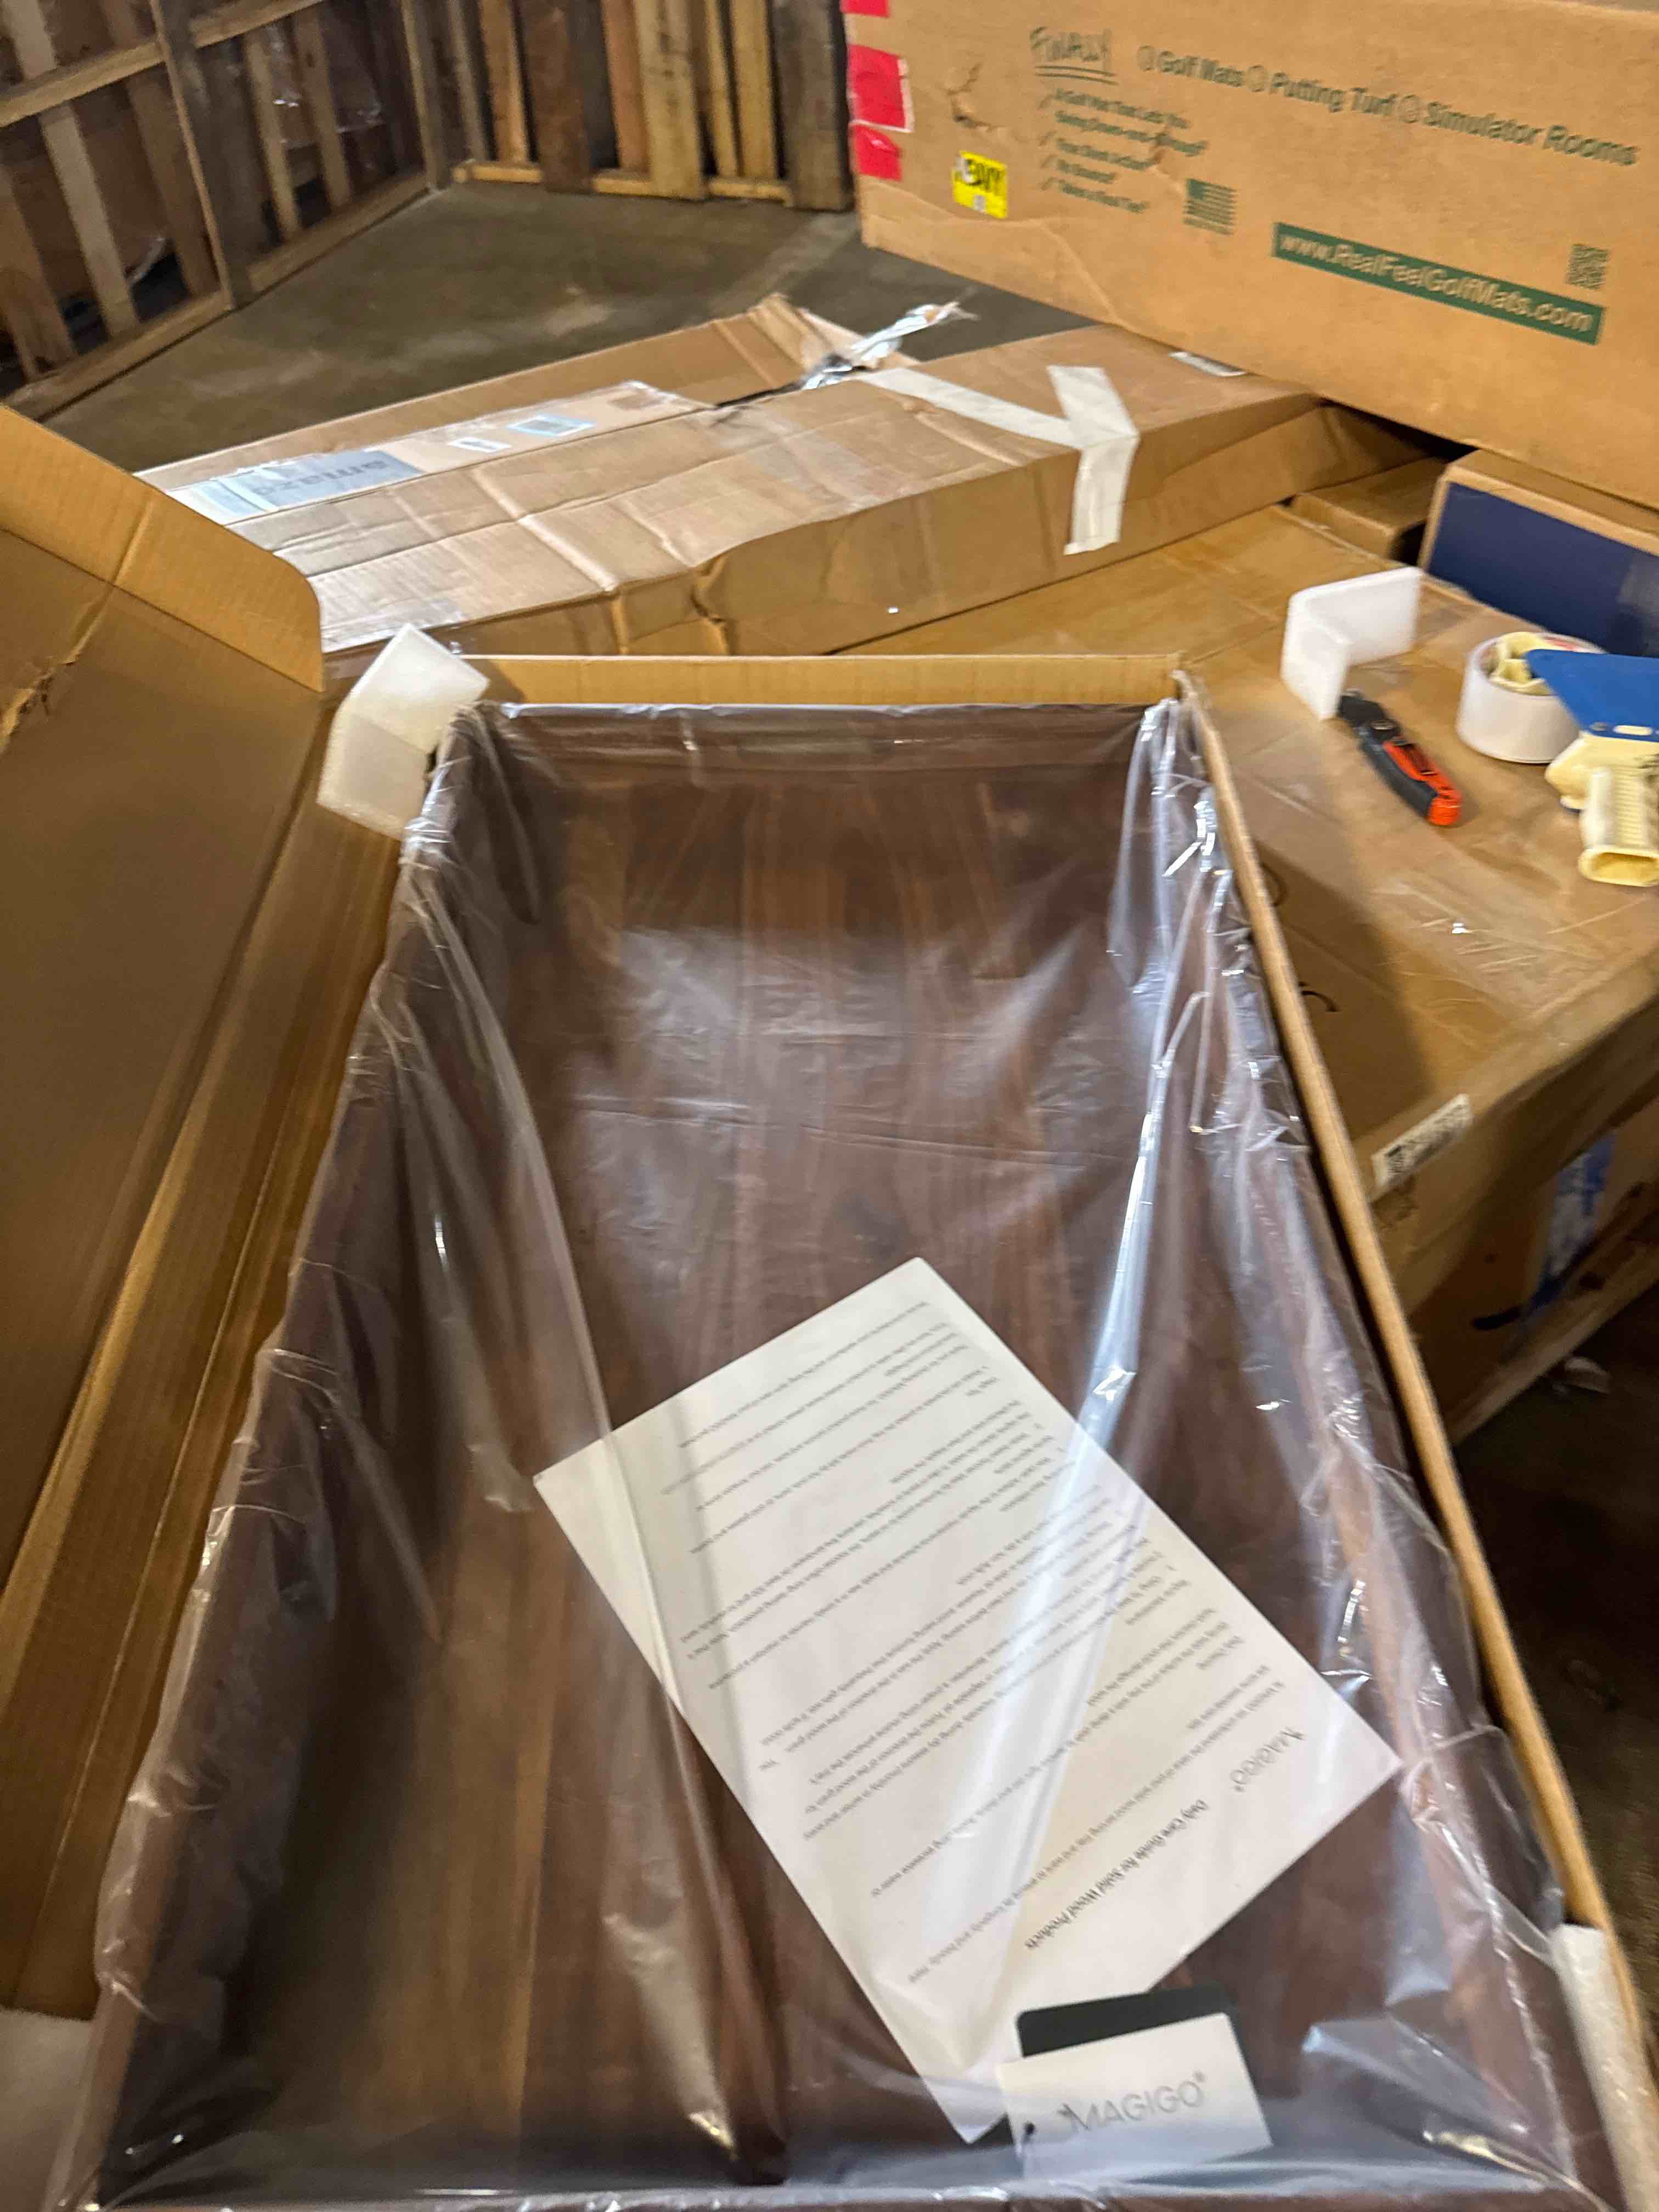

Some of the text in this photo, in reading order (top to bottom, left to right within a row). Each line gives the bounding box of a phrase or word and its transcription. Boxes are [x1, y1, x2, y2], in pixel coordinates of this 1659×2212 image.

[1269, 71, 1344, 112] Putting
[1351, 87, 1399, 116] Turf
[1424, 100, 1543, 145] Simulator
[1542, 124, 1639, 166] Rooms
[1279, 233, 1593, 332] www.RealFeelGolfMats.com
[1021, 1797, 1210, 1951] Daily Care Guide for Solid Wood Products
[1061, 2080, 1204, 2132] MAGIGO
